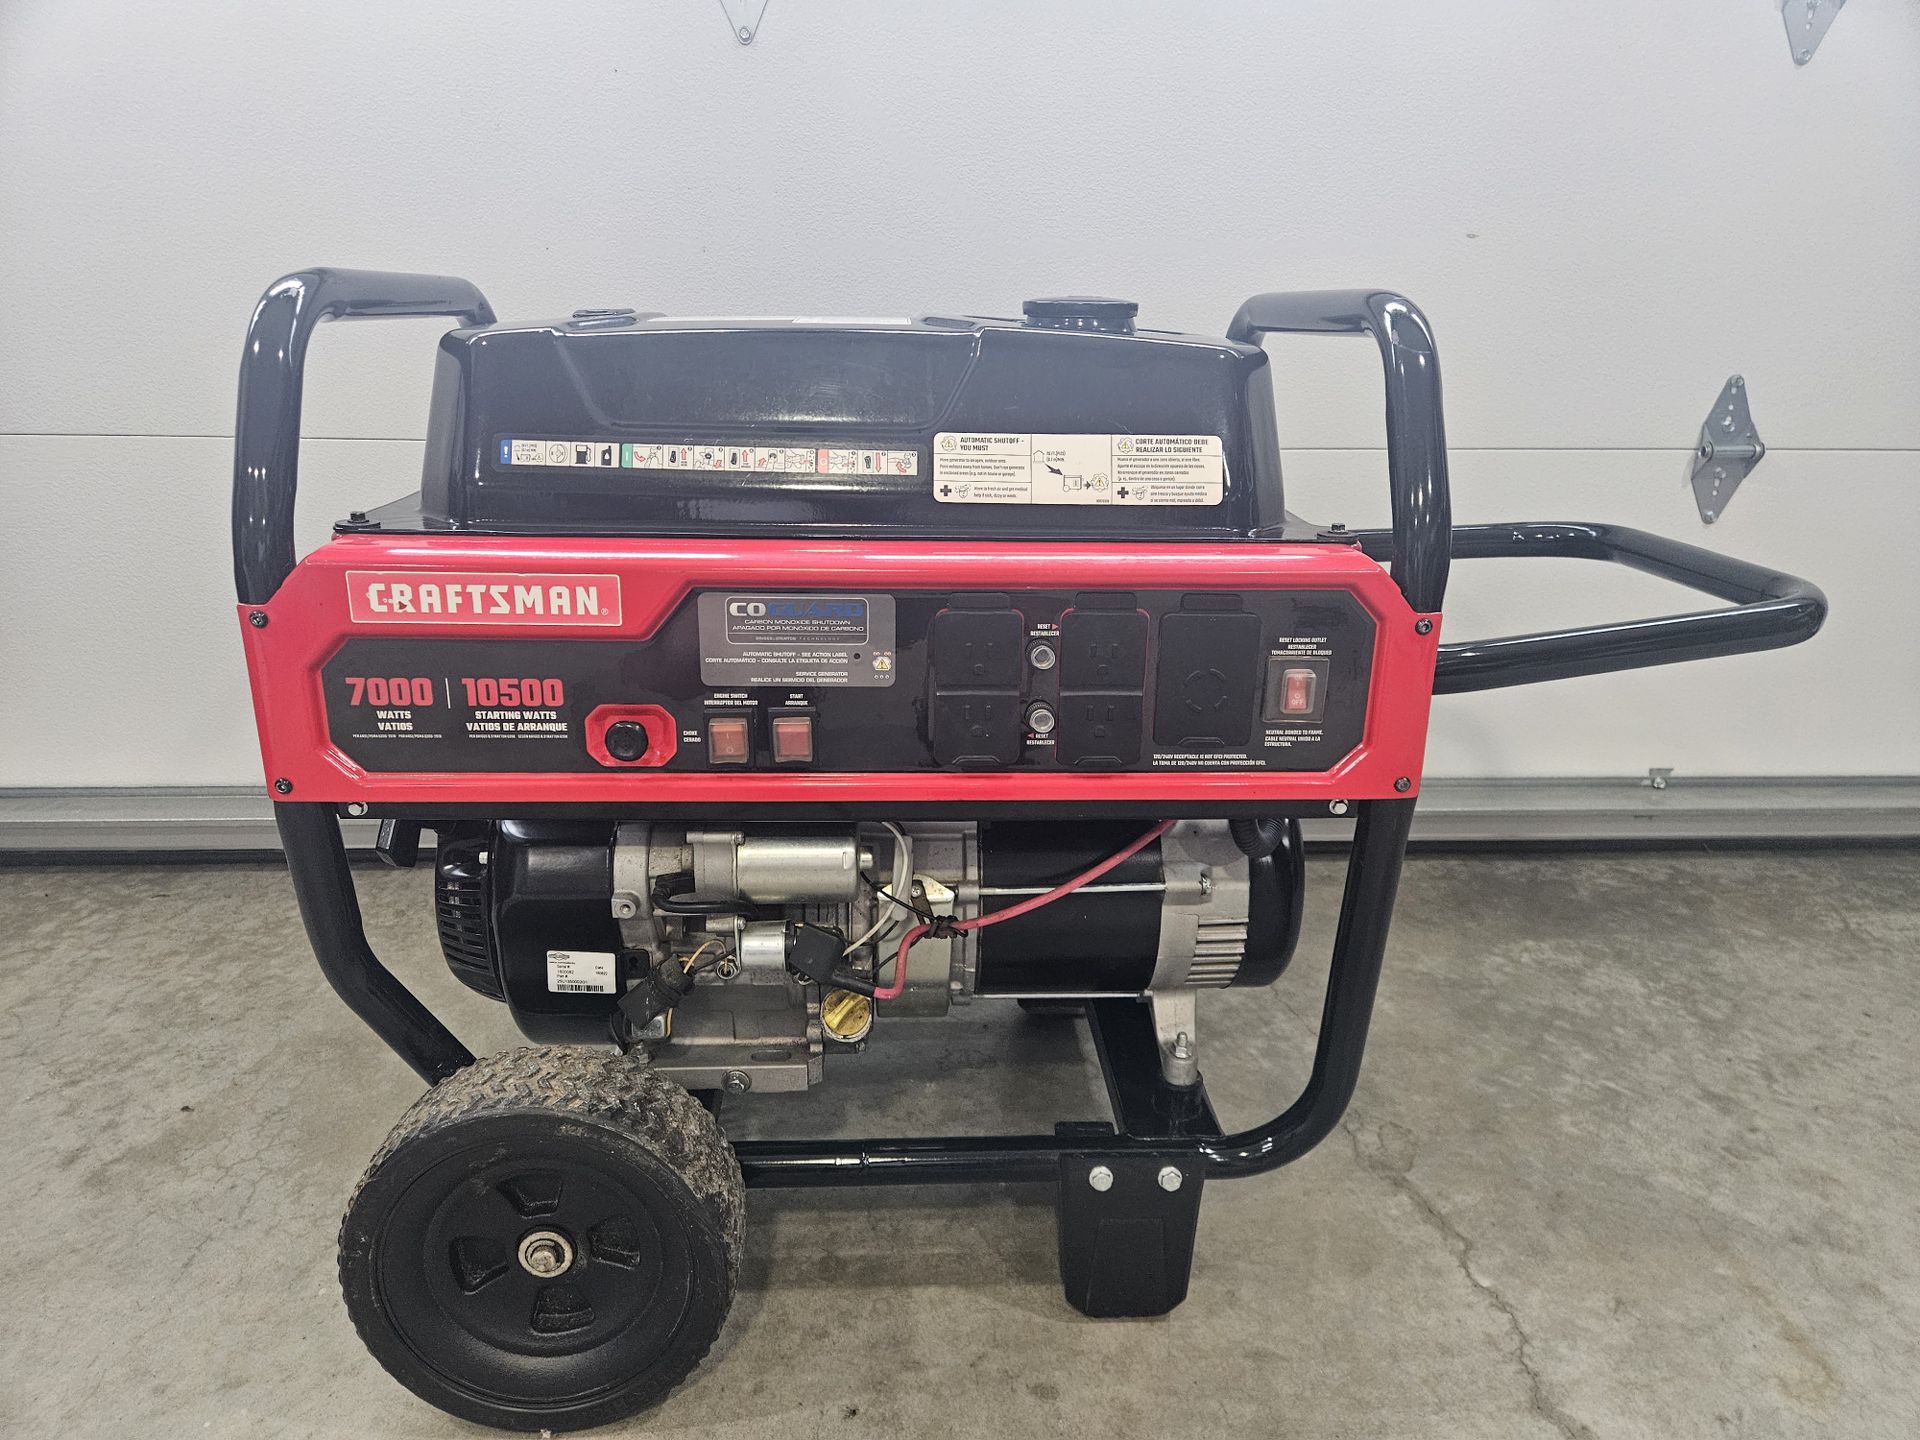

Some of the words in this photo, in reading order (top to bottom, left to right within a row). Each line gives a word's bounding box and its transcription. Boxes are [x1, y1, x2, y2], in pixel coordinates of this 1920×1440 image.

[366, 583, 599, 615] CRAFTSMAN
[345, 677, 433, 706] 7000
[461, 678, 564, 706] 10500
[376, 711, 412, 719] WATTS
[475, 711, 520, 719] STARTING
[523, 711, 557, 719] WATTS
[378, 722, 413, 730] VATIOS
[466, 722, 500, 731] VATIOS
[503, 723, 515, 731] DE
[517, 723, 568, 732] ARRANQUE
